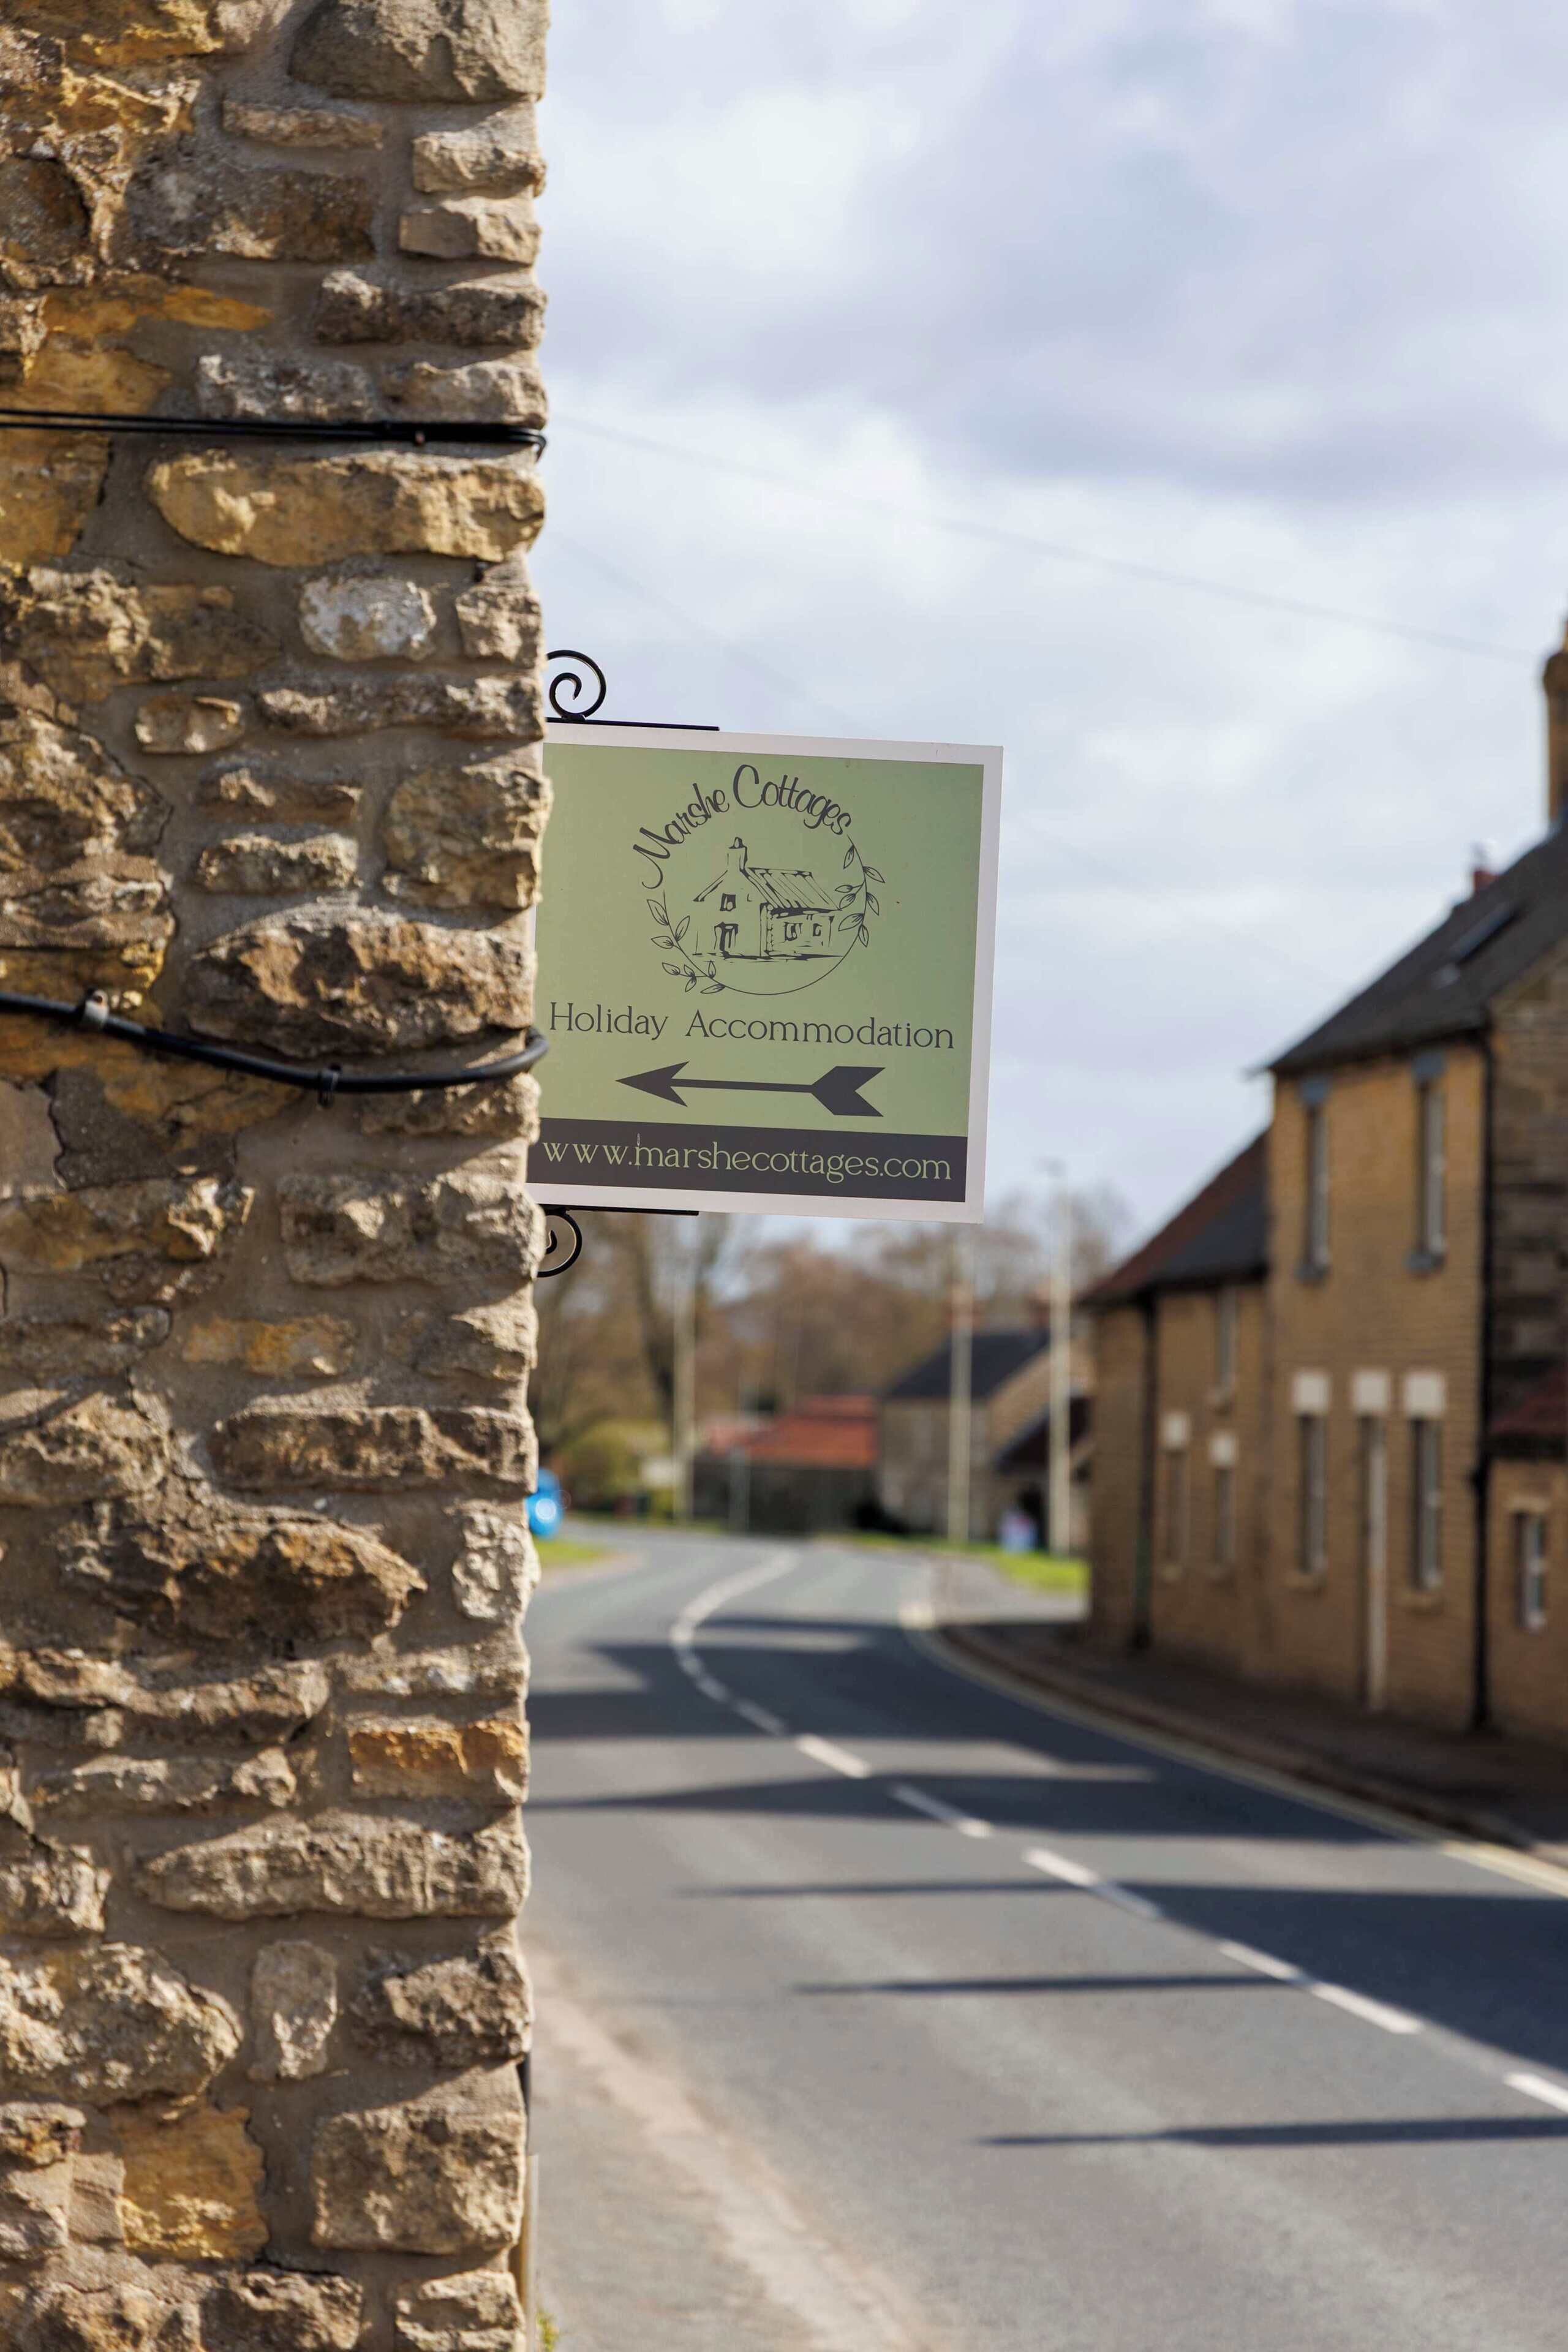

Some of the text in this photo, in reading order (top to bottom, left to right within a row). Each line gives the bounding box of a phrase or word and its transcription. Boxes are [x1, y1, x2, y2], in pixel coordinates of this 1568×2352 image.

[633, 764, 851, 889] Marshe Cottages
[549, 1001, 955, 1049] Holiday Accommodation
[542, 1141, 951, 1183] www.marshecottages.com
